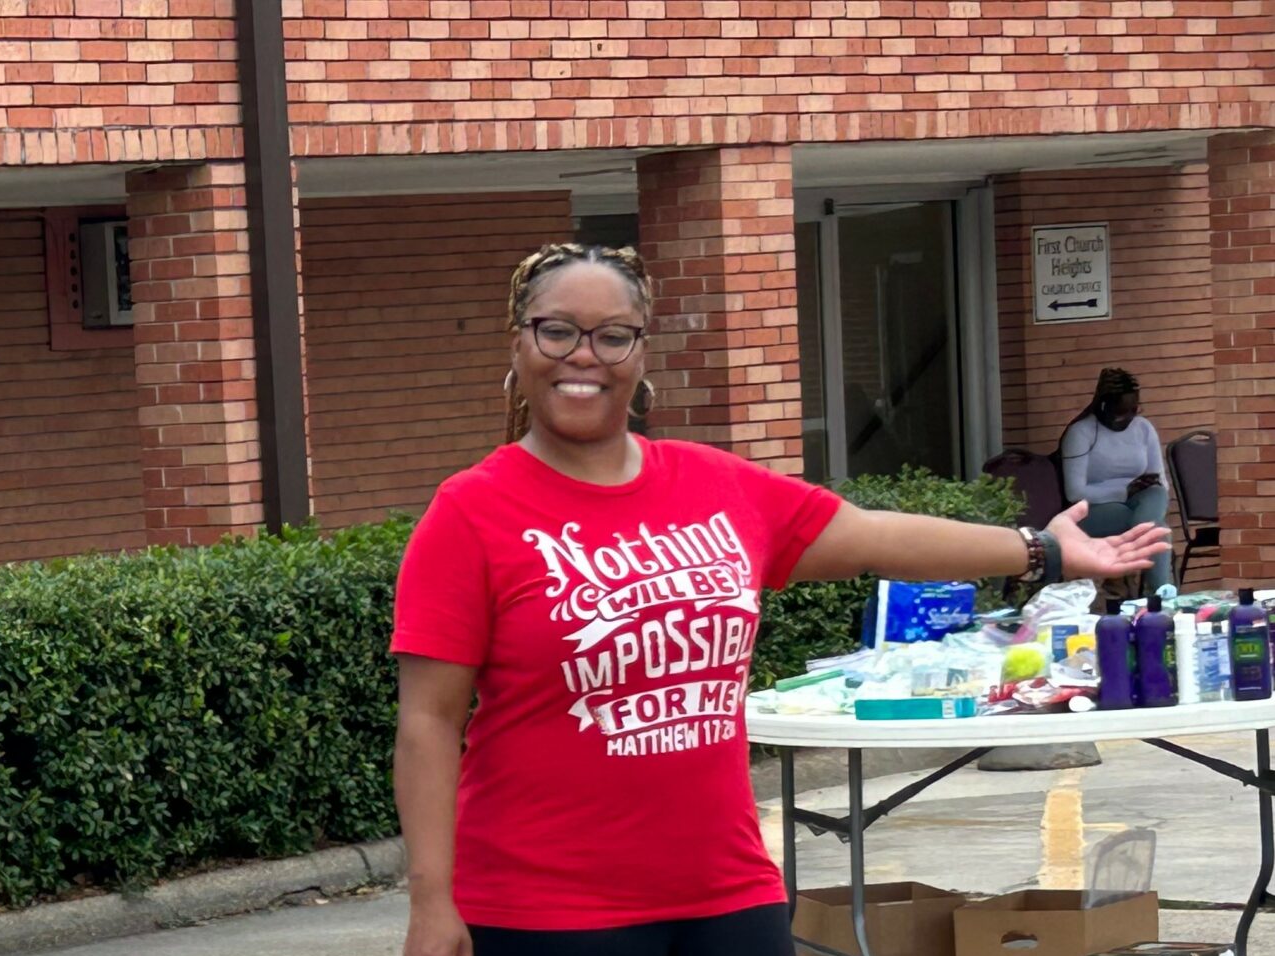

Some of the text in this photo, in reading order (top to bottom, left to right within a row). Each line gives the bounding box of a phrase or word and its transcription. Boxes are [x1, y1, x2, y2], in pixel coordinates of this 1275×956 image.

[1037, 235, 1104, 255] First Church
[1051, 258, 1092, 278] Heights
[522, 511, 751, 598] Nothing
[608, 569, 735, 613] WILL BE
[561, 609, 757, 693] IMPOSSIBL
[610, 682, 736, 730] FOR ME
[607, 720, 700, 756] MATTHEW
